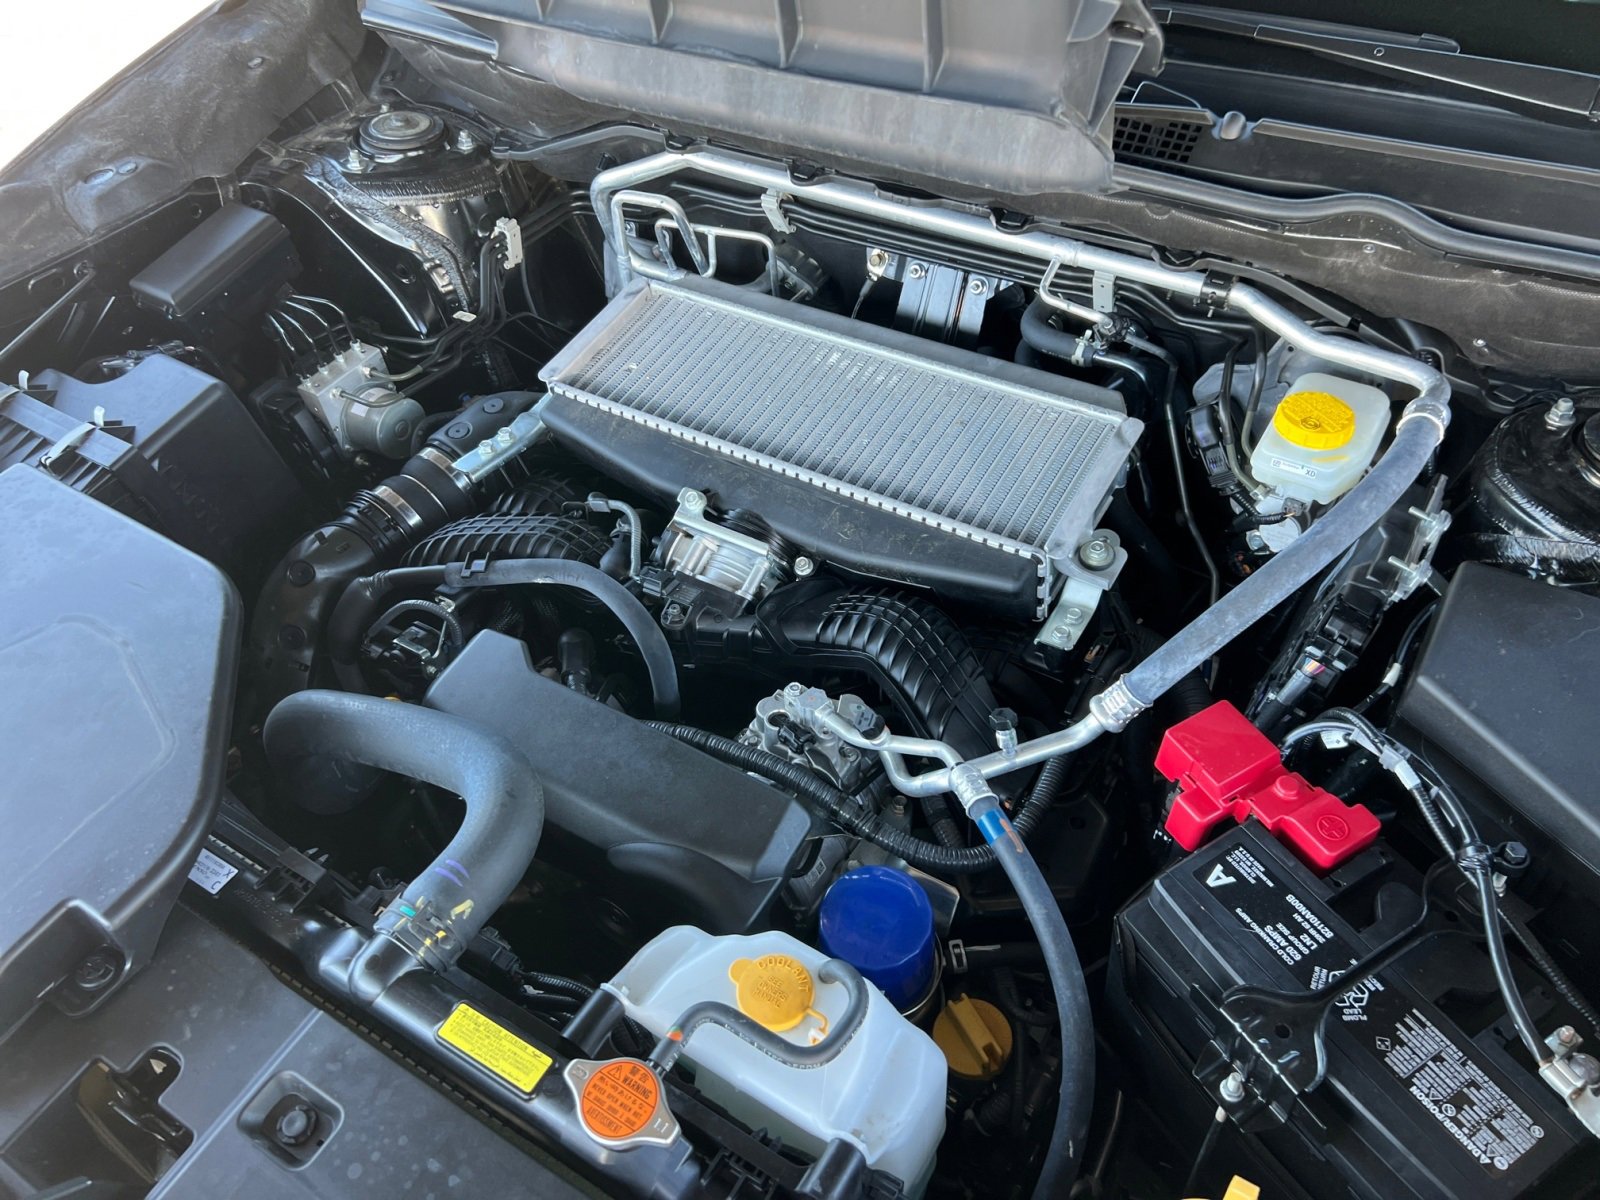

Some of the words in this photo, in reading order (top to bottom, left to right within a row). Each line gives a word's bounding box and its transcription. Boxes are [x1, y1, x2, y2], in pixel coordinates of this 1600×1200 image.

[1205, 862, 1236, 888] A
[1234, 906, 1253, 924] AMPS
[1292, 912, 1304, 923] AH
[1250, 920, 1280, 950] CRANKING
[1263, 923, 1289, 948] AMPS
[1275, 921, 1290, 936] SIZE
[1287, 933, 1310, 955] GROUP
[1299, 931, 1318, 950] LN2
[1276, 947, 1295, 966] COLD
[1285, 944, 1302, 961] 620
[757, 957, 809, 992] COOLANT
[1310, 965, 1321, 989] RETOUR
[621, 1075, 652, 1100] WARNING
[1408, 1084, 1482, 1157] DANGER/POISON
